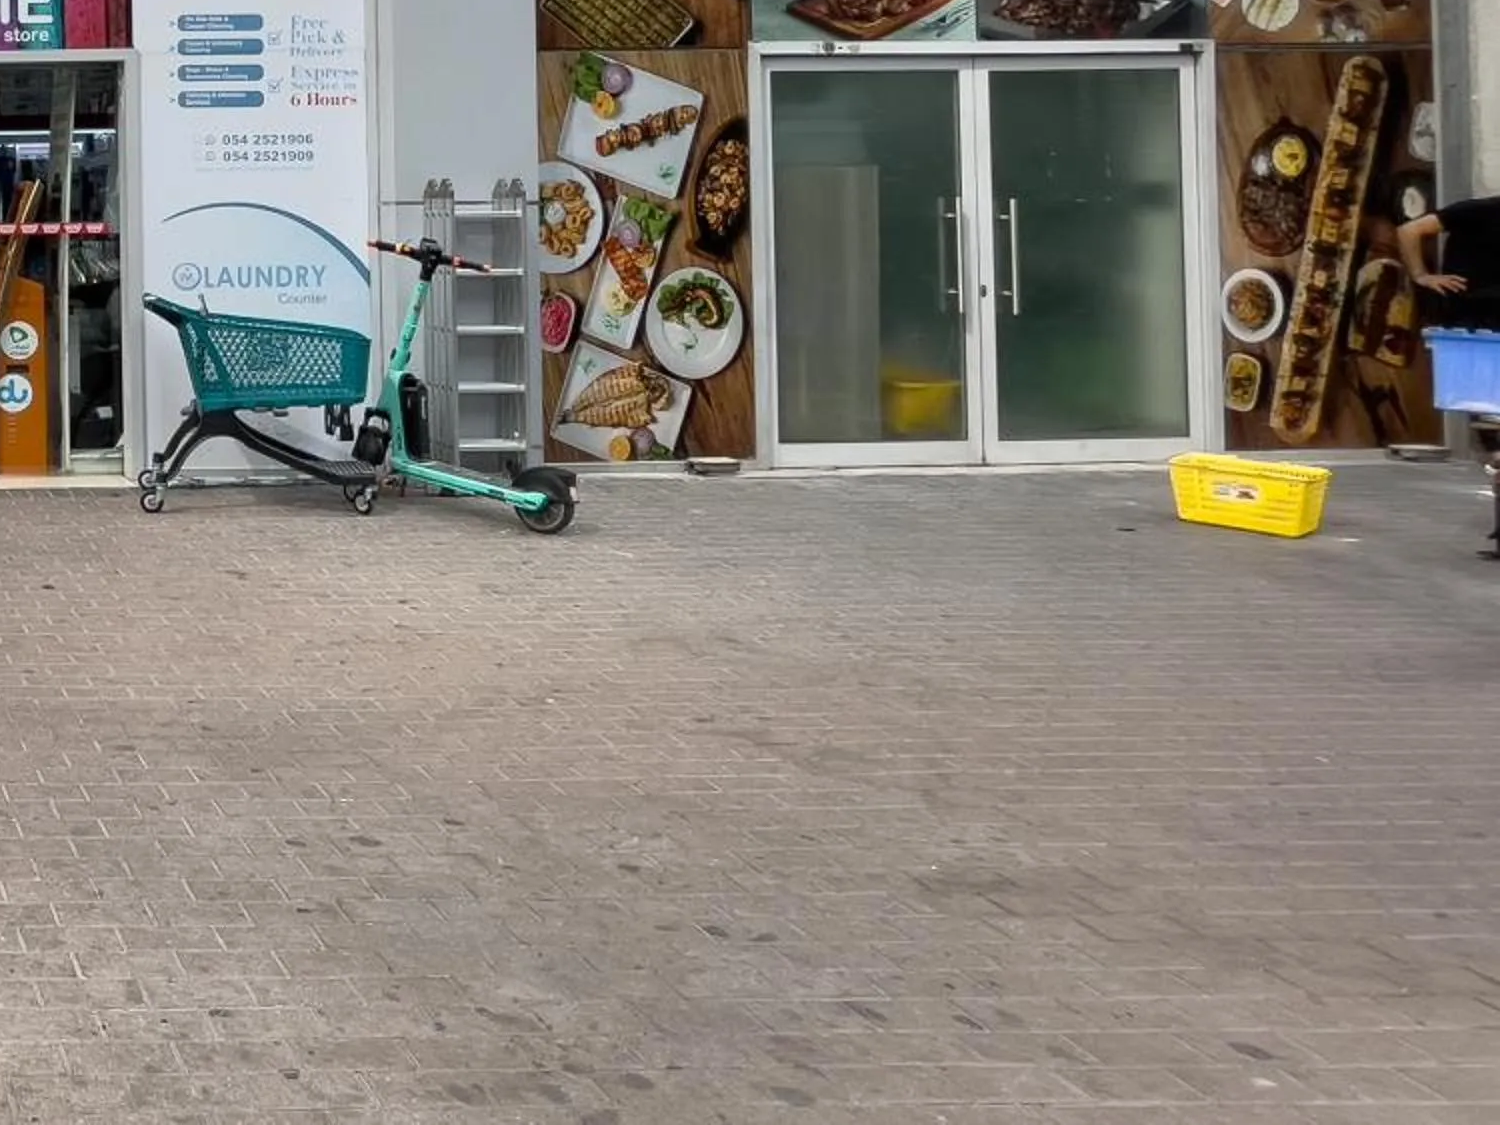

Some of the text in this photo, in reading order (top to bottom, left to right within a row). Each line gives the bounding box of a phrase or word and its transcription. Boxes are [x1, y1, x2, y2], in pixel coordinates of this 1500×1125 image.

[291, 14, 326, 28] Free
[4, 28, 50, 42] store
[291, 29, 327, 44] Pick
[291, 65, 359, 81] Express
[306, 92, 358, 106] Hours
[222, 134, 248, 145] 054
[223, 151, 248, 162] 054
[203, 266, 328, 288] LAUNDRY
[277, 293, 328, 304] Counter
